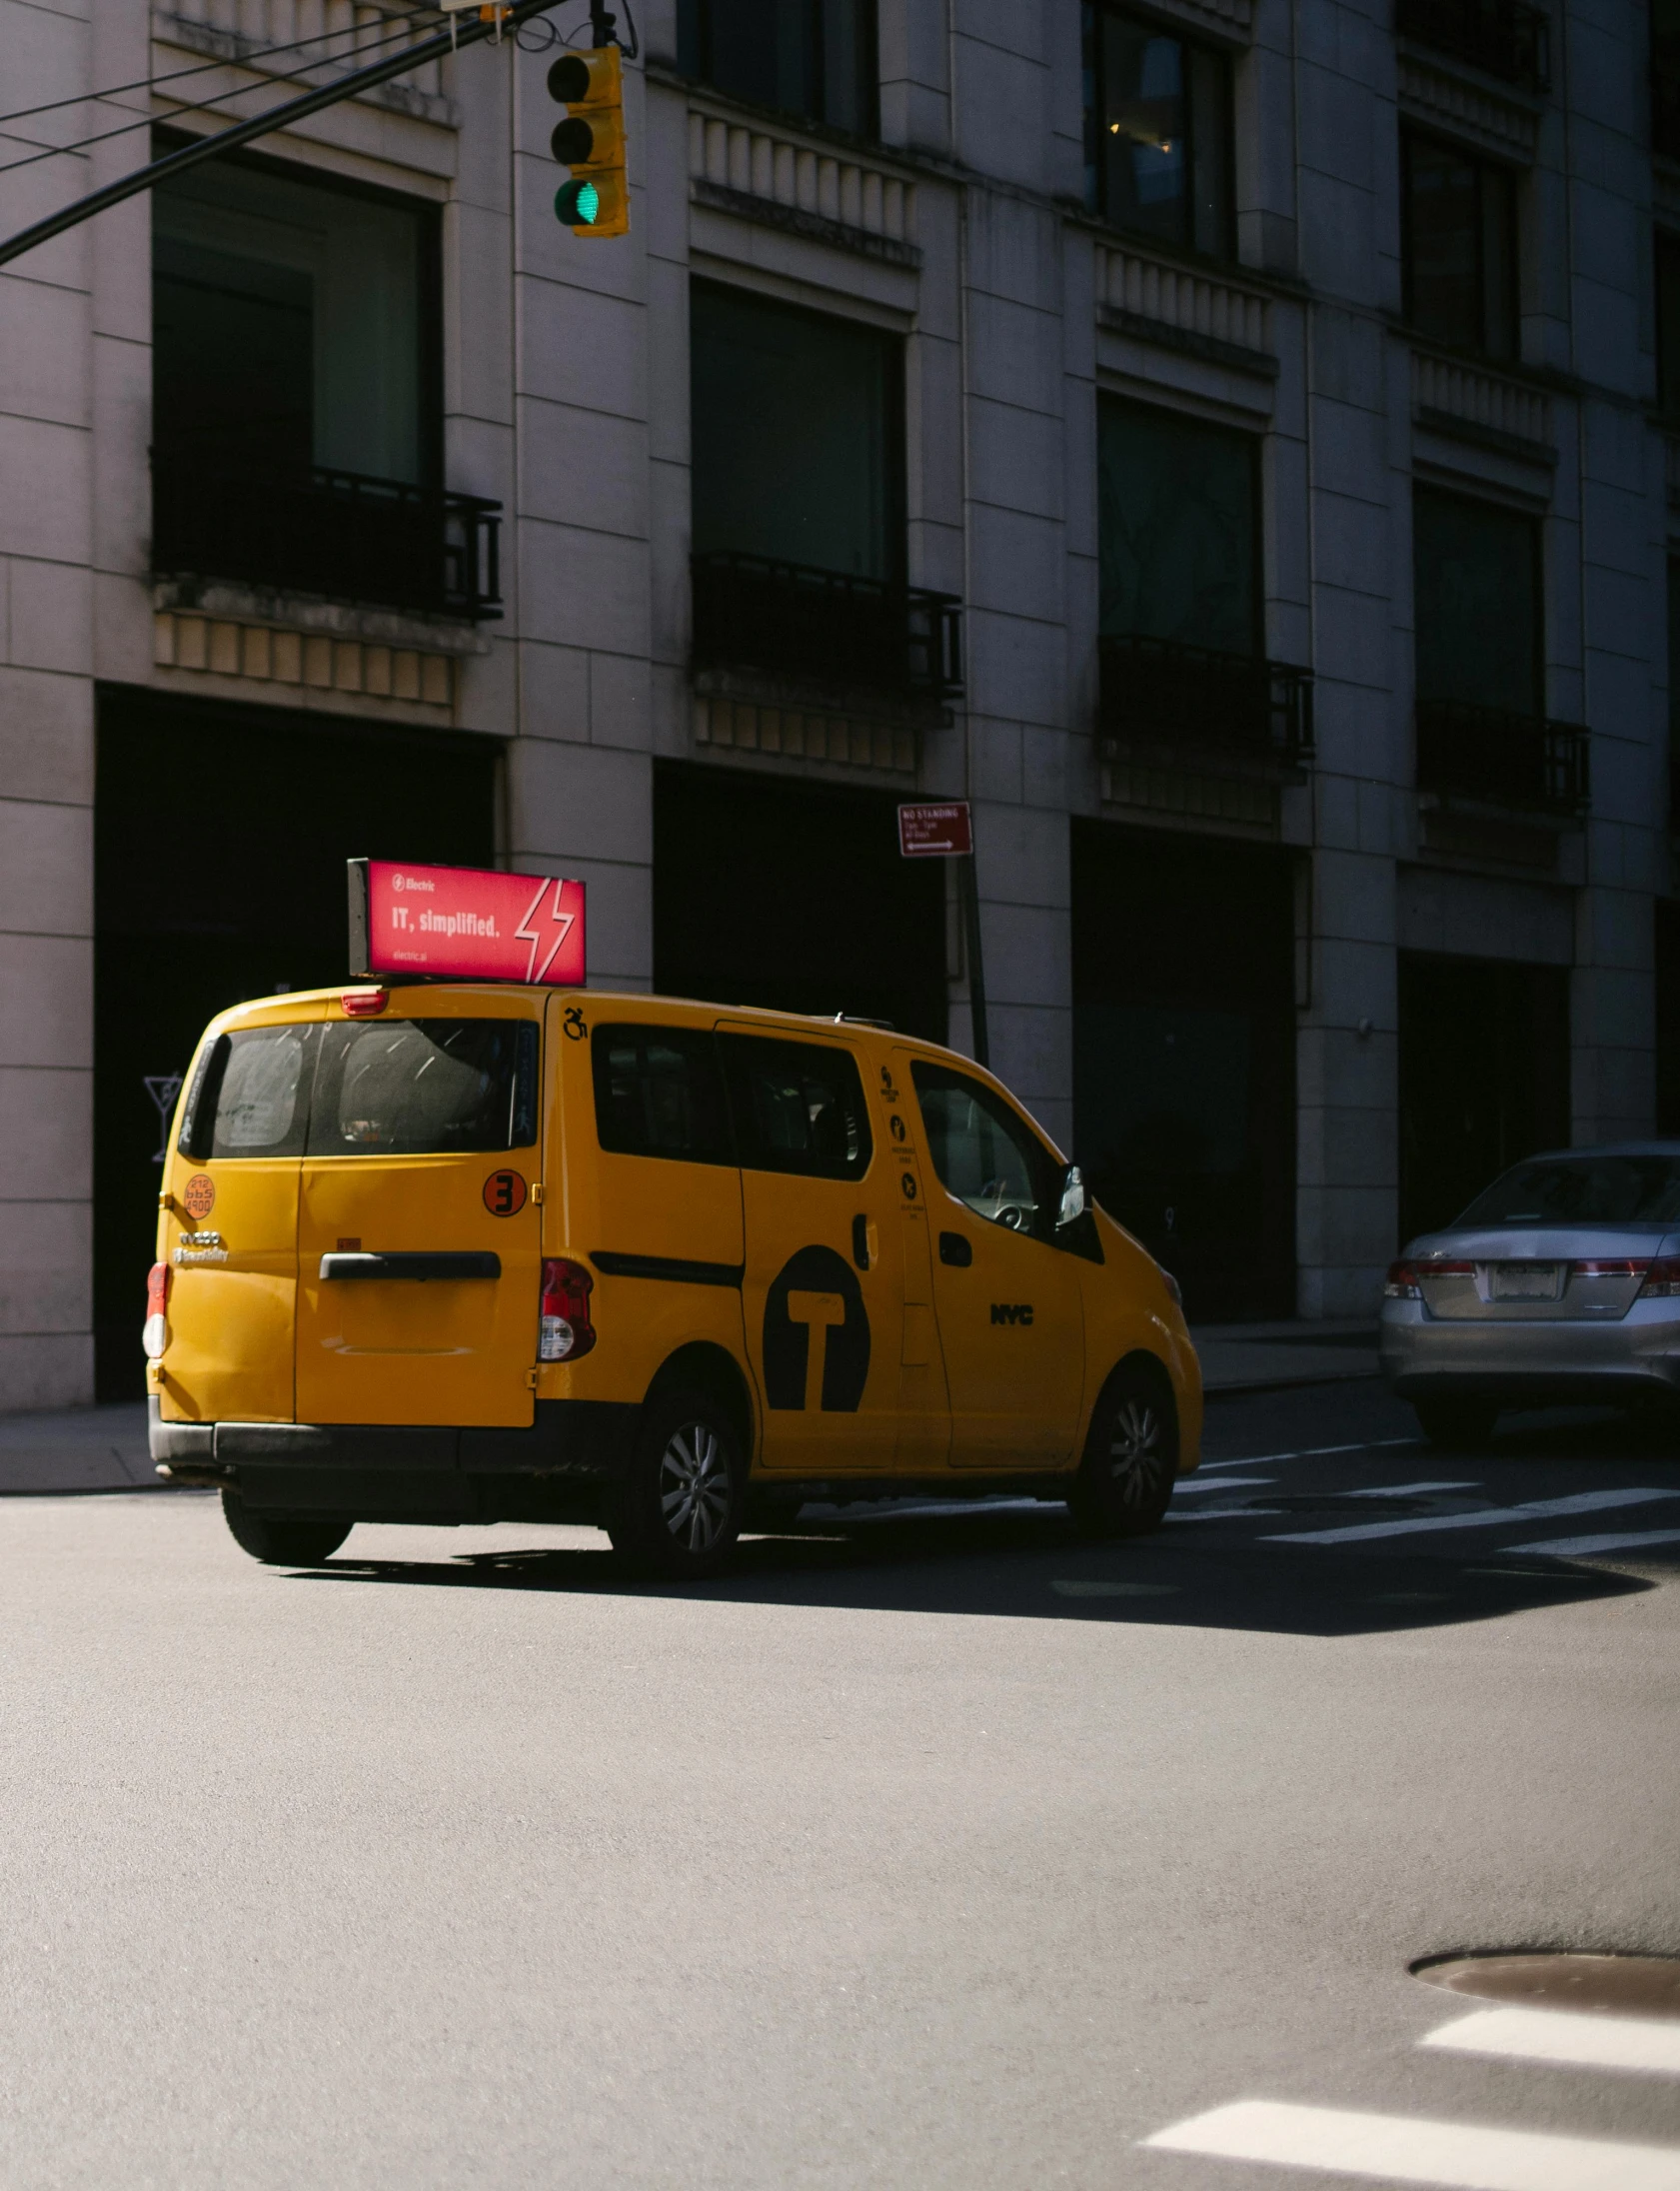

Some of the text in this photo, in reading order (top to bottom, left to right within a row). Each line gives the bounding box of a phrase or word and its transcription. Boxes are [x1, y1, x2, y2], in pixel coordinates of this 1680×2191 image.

[902, 807, 958, 820] NO STANDING
[405, 877, 436, 893] Electric
[392, 907, 500, 938] IT, simplified.
[393, 951, 428, 963] electric.ai
[191, 1179, 209, 1188] 212
[495, 1174, 514, 1212] 3
[187, 1199, 211, 1212] 4900
[990, 1303, 1034, 1325] NYC
